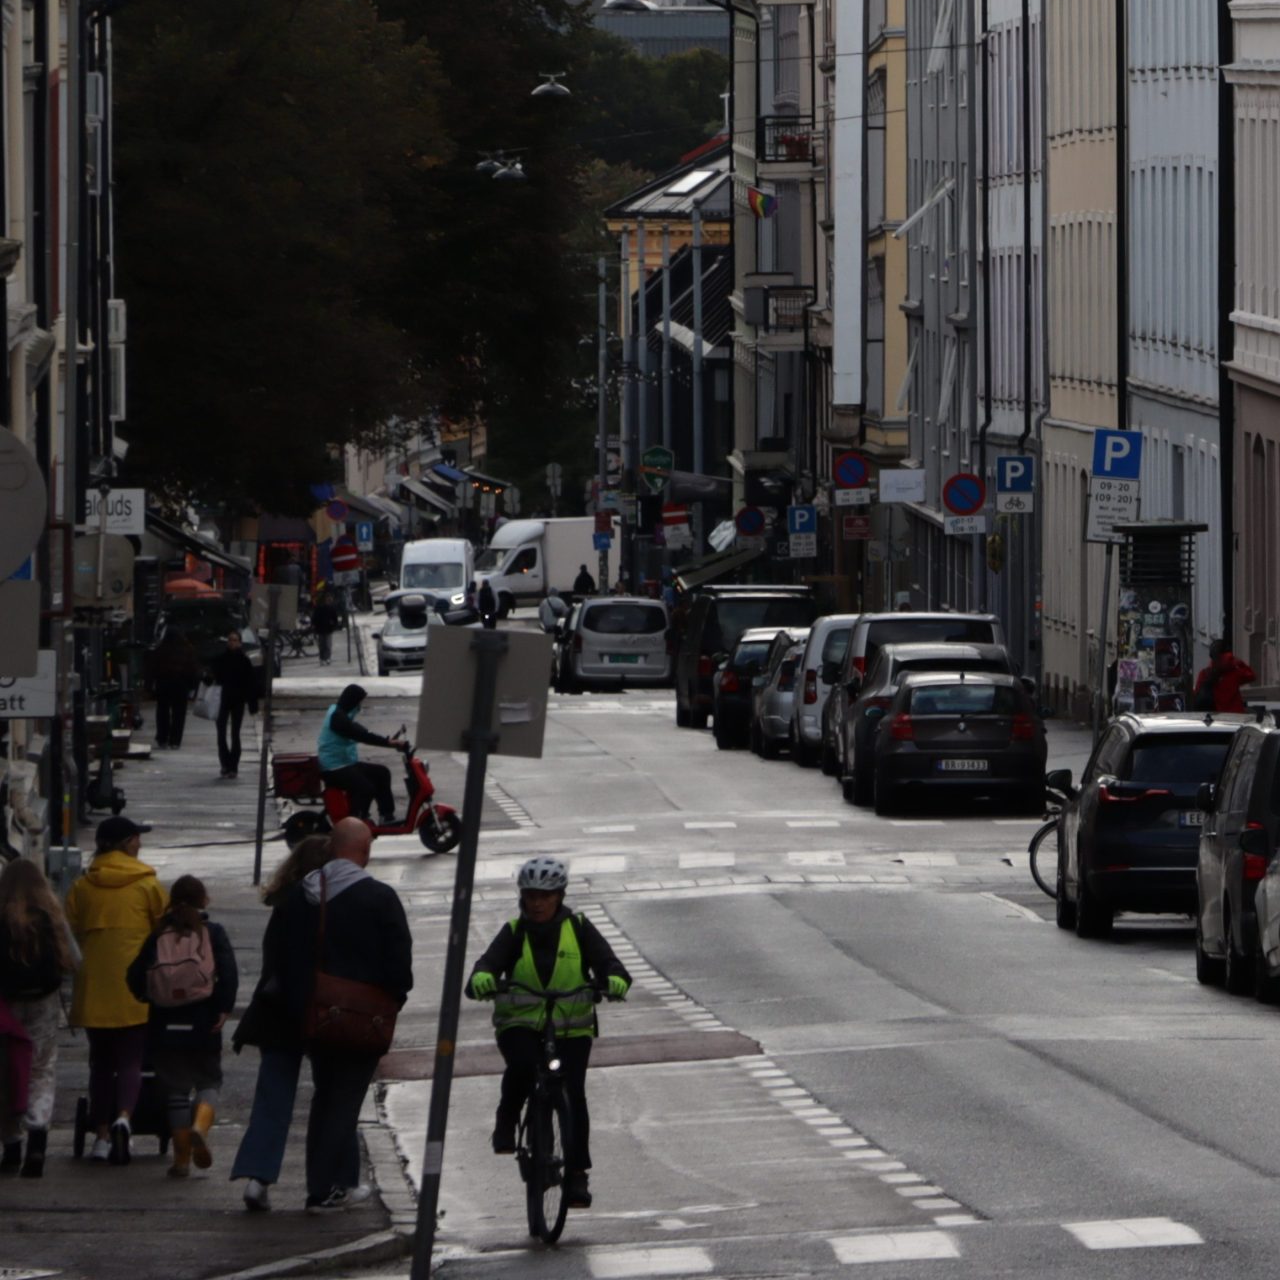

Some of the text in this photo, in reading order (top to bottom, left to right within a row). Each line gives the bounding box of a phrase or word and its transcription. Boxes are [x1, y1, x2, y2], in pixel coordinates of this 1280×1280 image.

[1104, 435, 1131, 471] P
[1005, 460, 1025, 488] P
[794, 509, 810, 530] P
